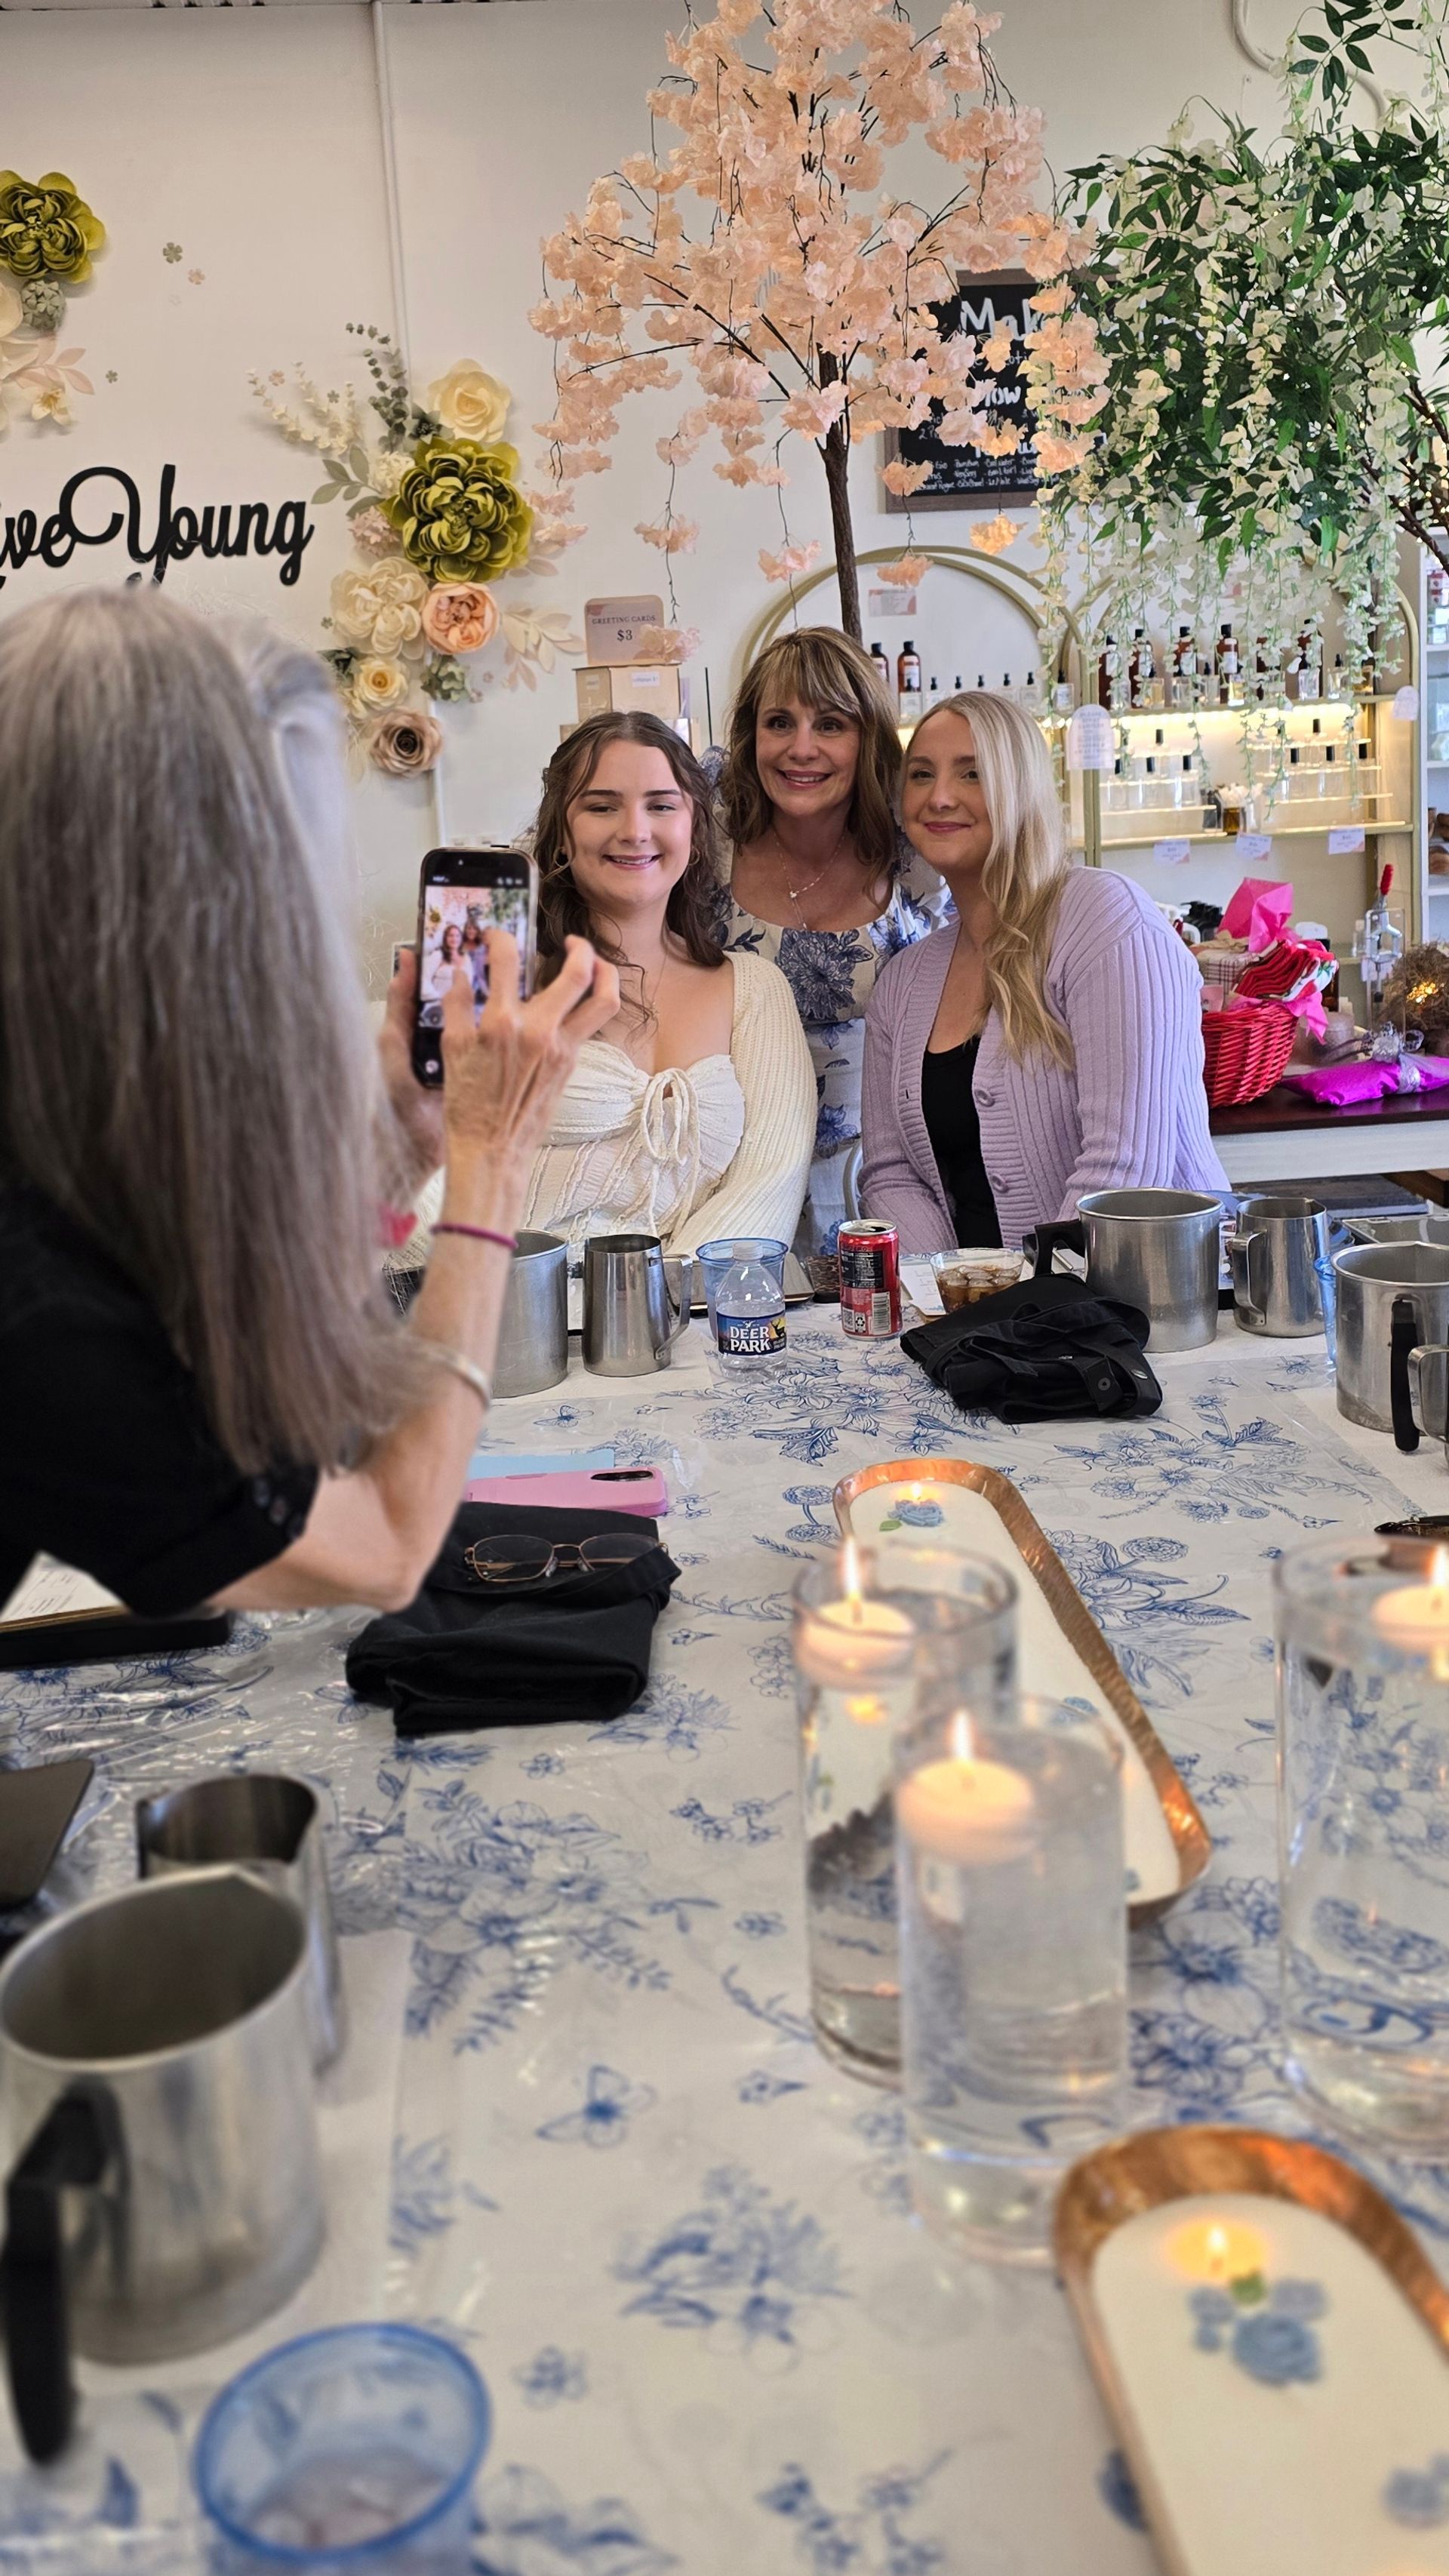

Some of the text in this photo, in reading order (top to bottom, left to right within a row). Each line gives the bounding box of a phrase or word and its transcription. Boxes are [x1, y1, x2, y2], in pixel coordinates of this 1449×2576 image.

[60, 463, 315, 587] Young
[592, 617, 629, 625] GREETING
[617, 629, 633, 642] $3
[730, 1326, 769, 1339] DEER
[730, 1338, 771, 1353] PARK
